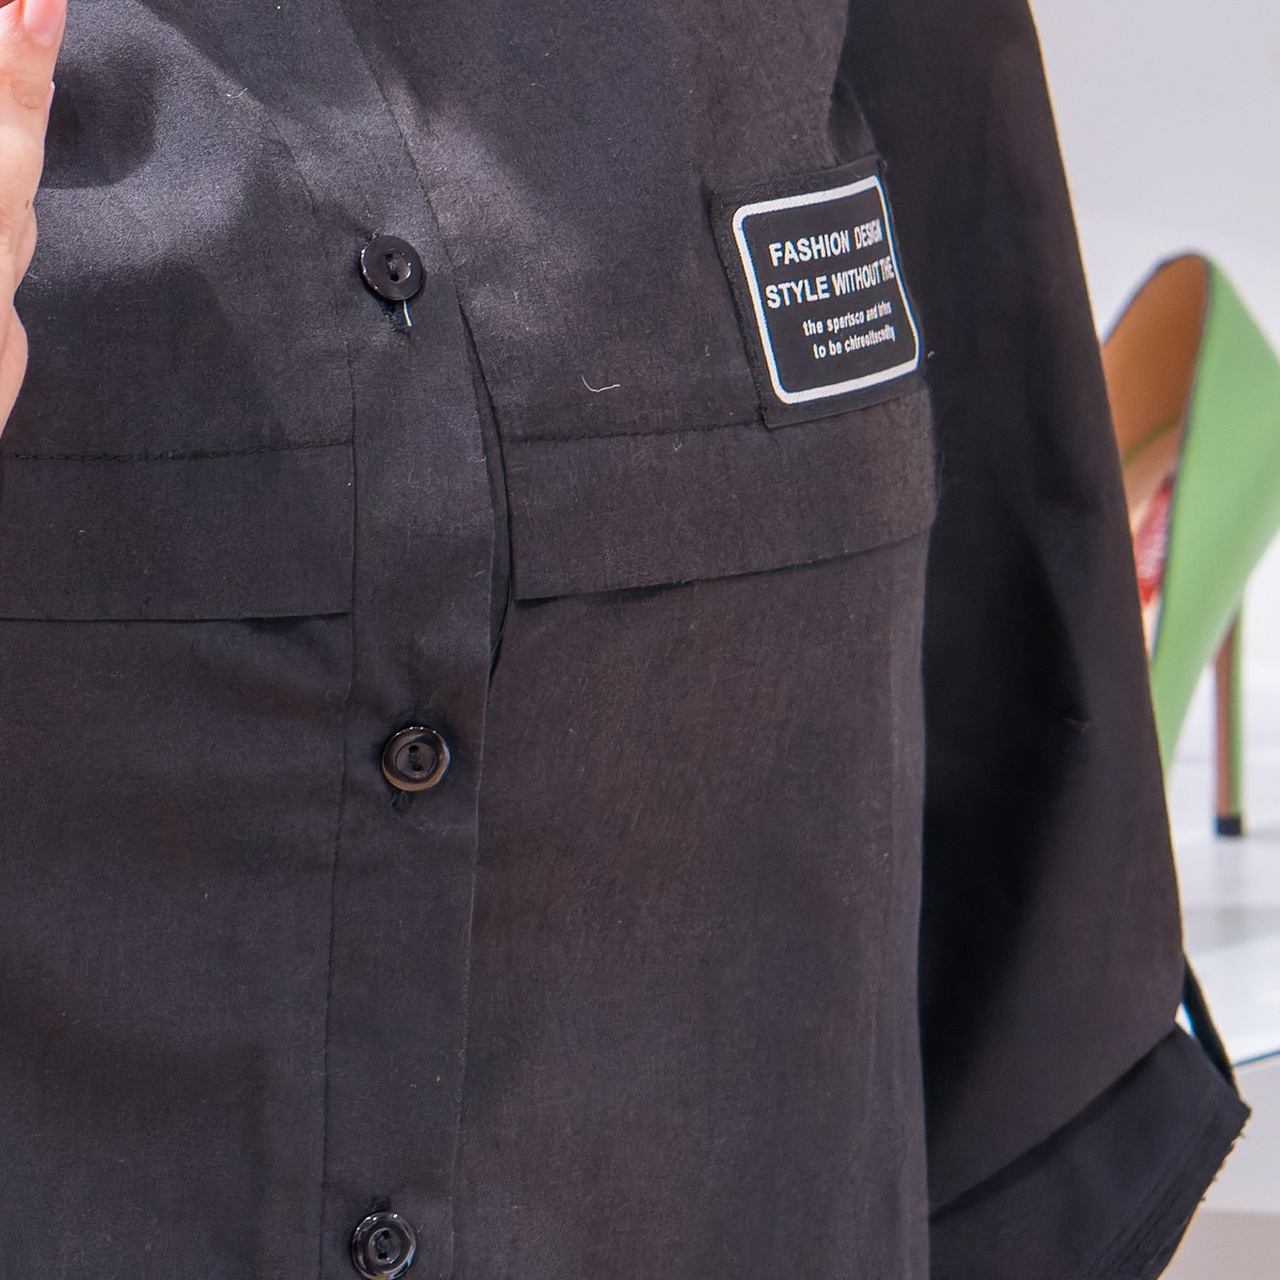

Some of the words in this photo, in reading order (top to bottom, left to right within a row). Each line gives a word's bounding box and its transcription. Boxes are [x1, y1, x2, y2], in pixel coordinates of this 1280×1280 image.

[768, 229, 851, 268] FASHION
[765, 275, 831, 309] STYLE
[831, 260, 881, 297] WITHOUT
[802, 319, 824, 337] the
[812, 343, 827, 359] to
[828, 339, 843, 356] be
